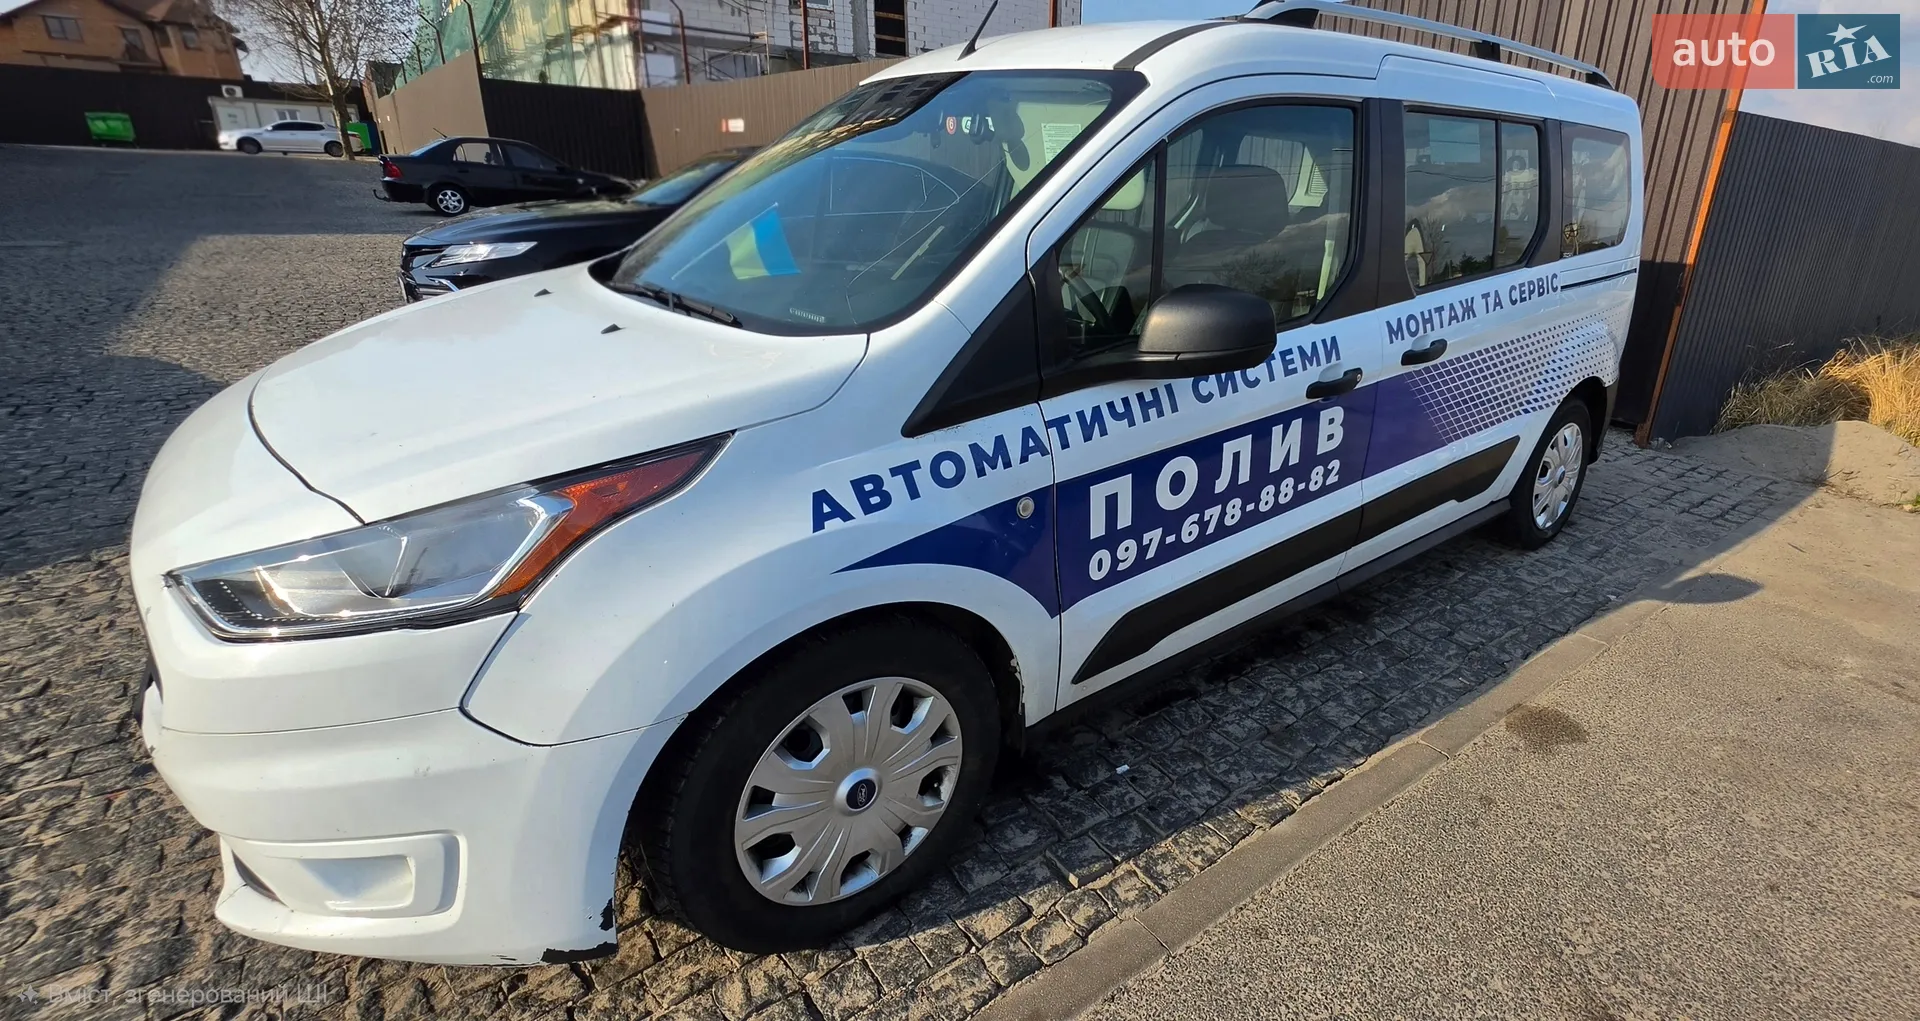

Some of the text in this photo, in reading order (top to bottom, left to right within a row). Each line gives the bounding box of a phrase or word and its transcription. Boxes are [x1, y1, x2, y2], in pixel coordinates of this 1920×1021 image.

[1385, 273, 1559, 344] МОНТАЖ ТА СЕРВІС
[811, 336, 1342, 533] АВТОМАТИЧНІ СИСТЕМИ
[1089, 406, 1345, 540] ПОЛИВ
[1088, 459, 1341, 581] 097-678-88-82
